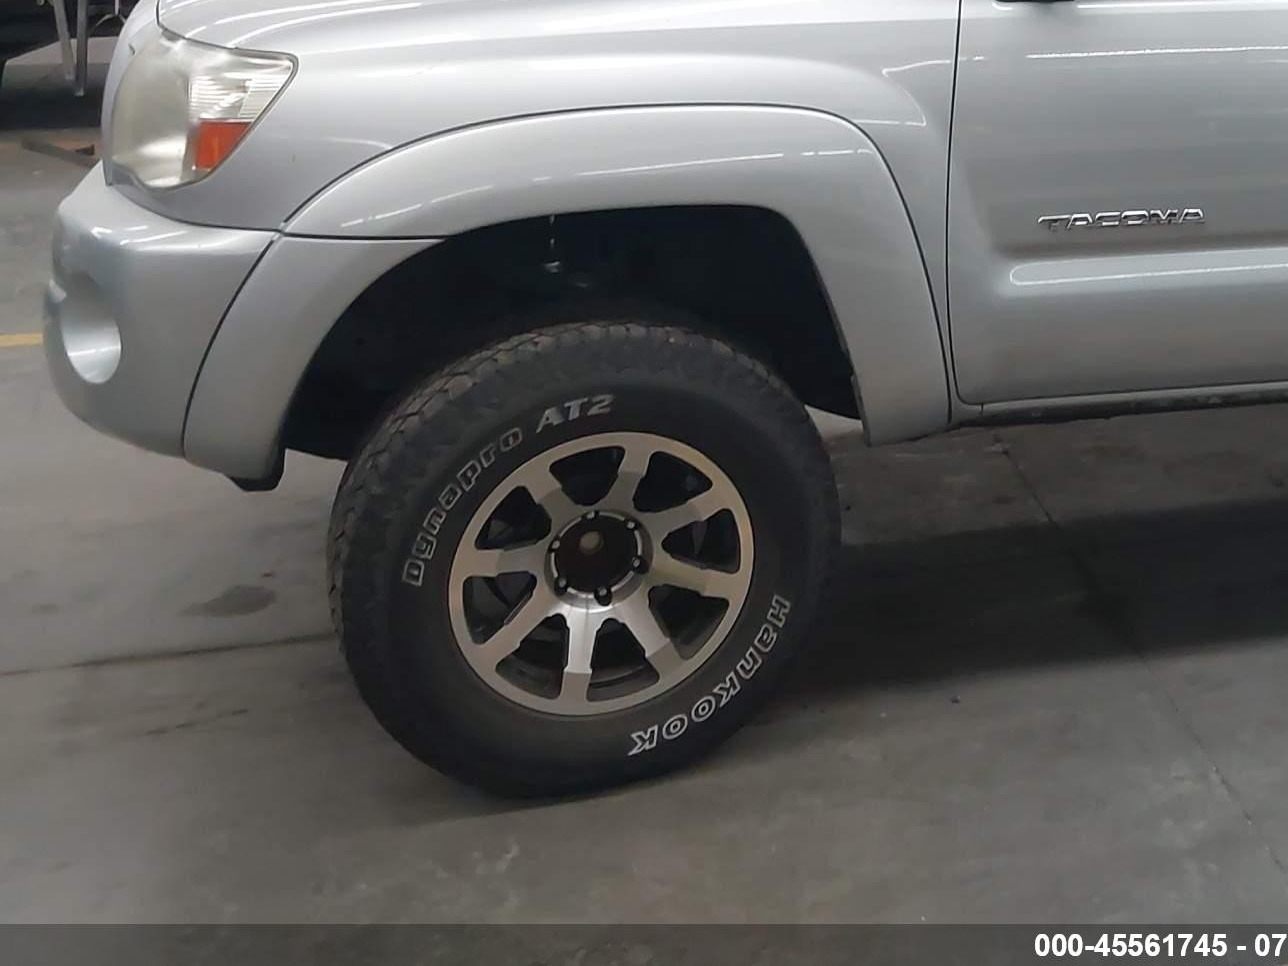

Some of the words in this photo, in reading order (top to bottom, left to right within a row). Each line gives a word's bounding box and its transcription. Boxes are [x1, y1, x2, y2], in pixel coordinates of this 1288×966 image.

[1037, 208, 1206, 232] TACOMA
[401, 427, 523, 587] Dynapro
[535, 393, 615, 434] AT2
